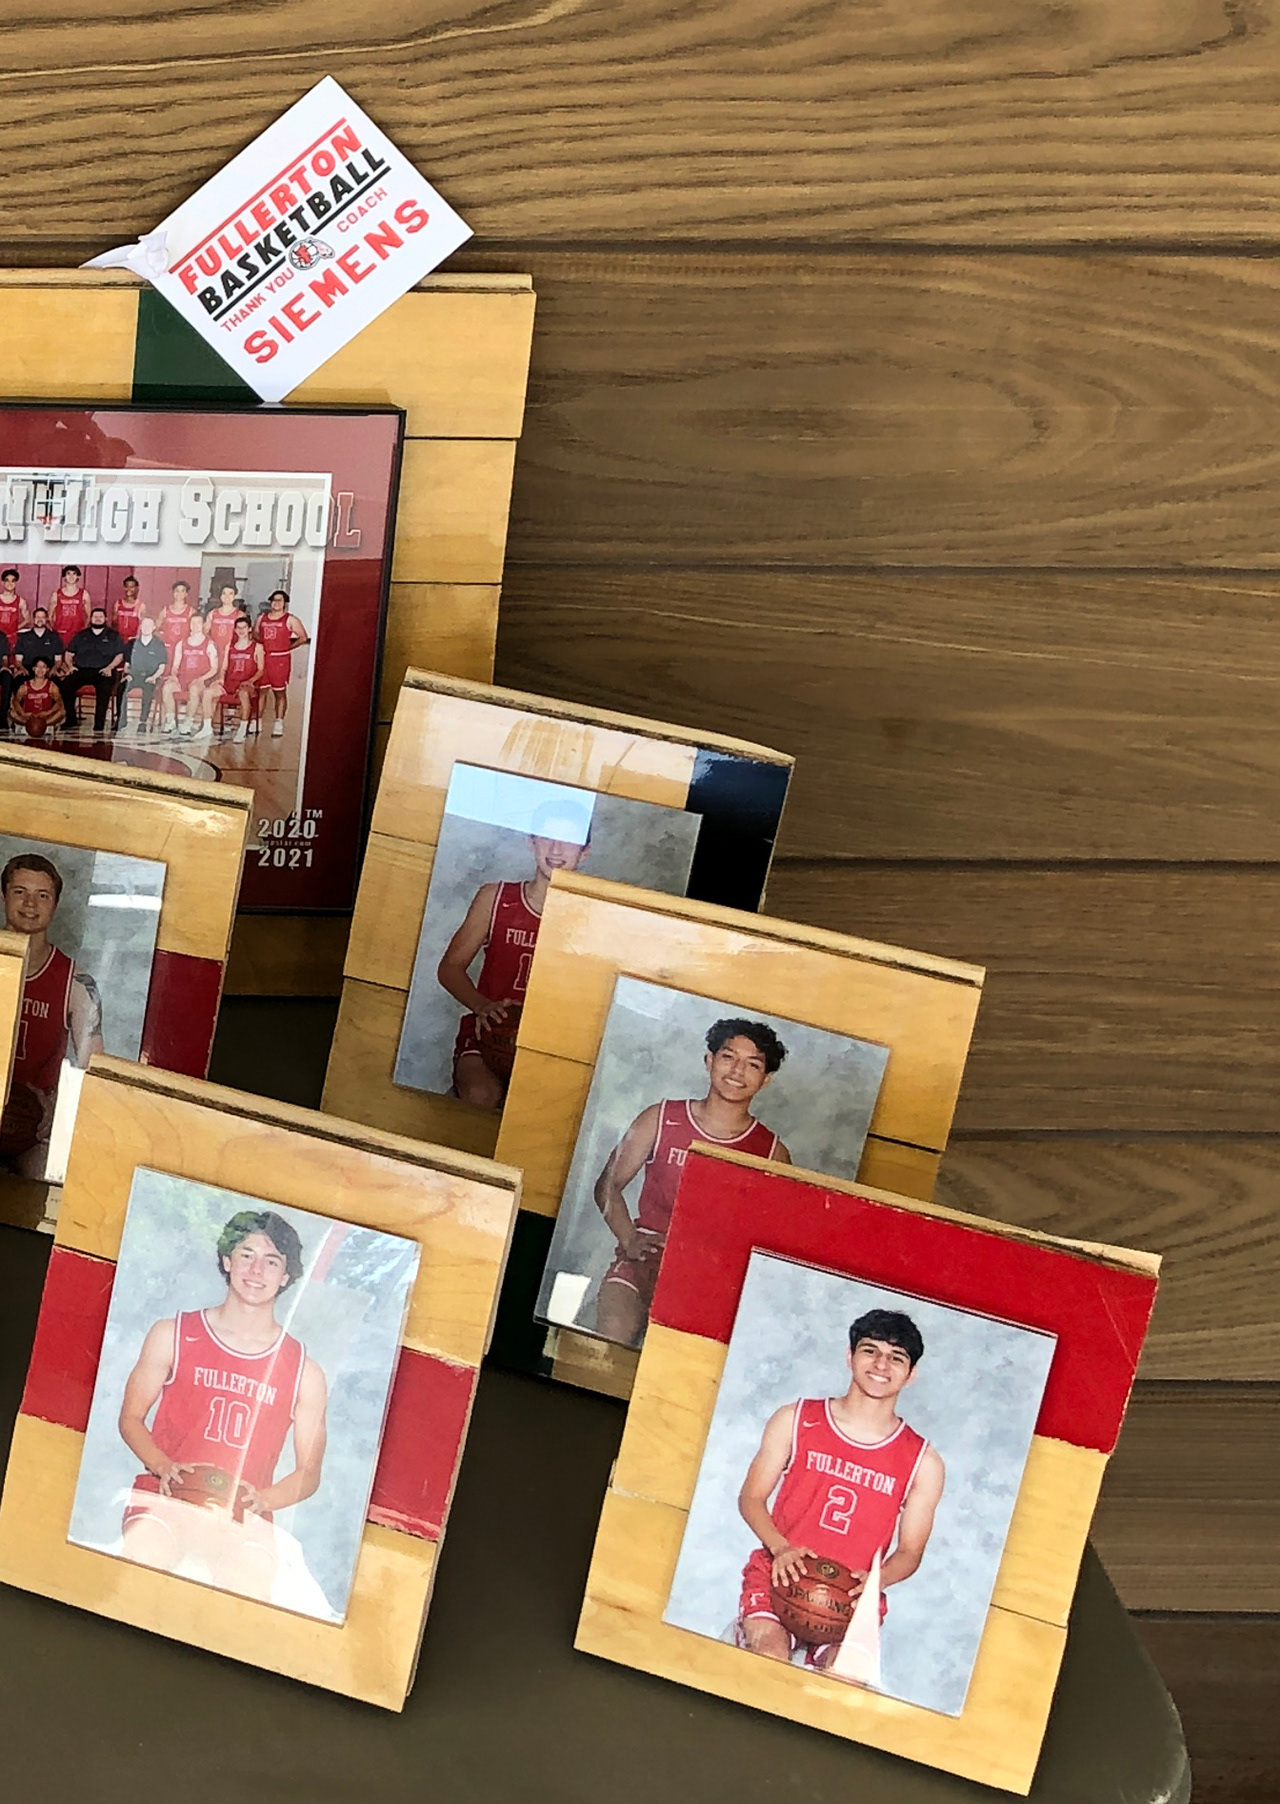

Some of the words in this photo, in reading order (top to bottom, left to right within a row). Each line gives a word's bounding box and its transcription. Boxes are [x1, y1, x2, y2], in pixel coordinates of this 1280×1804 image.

[178, 125, 362, 295] FULLERTON
[197, 148, 385, 315] BASKETBALL
[220, 293, 267, 333] THANK
[264, 270, 294, 295] YOU
[336, 187, 388, 233] COACH
[243, 199, 430, 363] SIEMENS
[43, 477, 163, 543] HIGH
[178, 476, 361, 548] SCHOOL
[258, 819, 316, 839] 2020
[305, 809, 323, 818] TM
[258, 848, 313, 867] 2021
[193, 1365, 278, 1406] FULLERTON
[203, 1396, 252, 1449] 10
[805, 1450, 897, 1497] FULLERTON
[818, 1485, 859, 1535] 2
